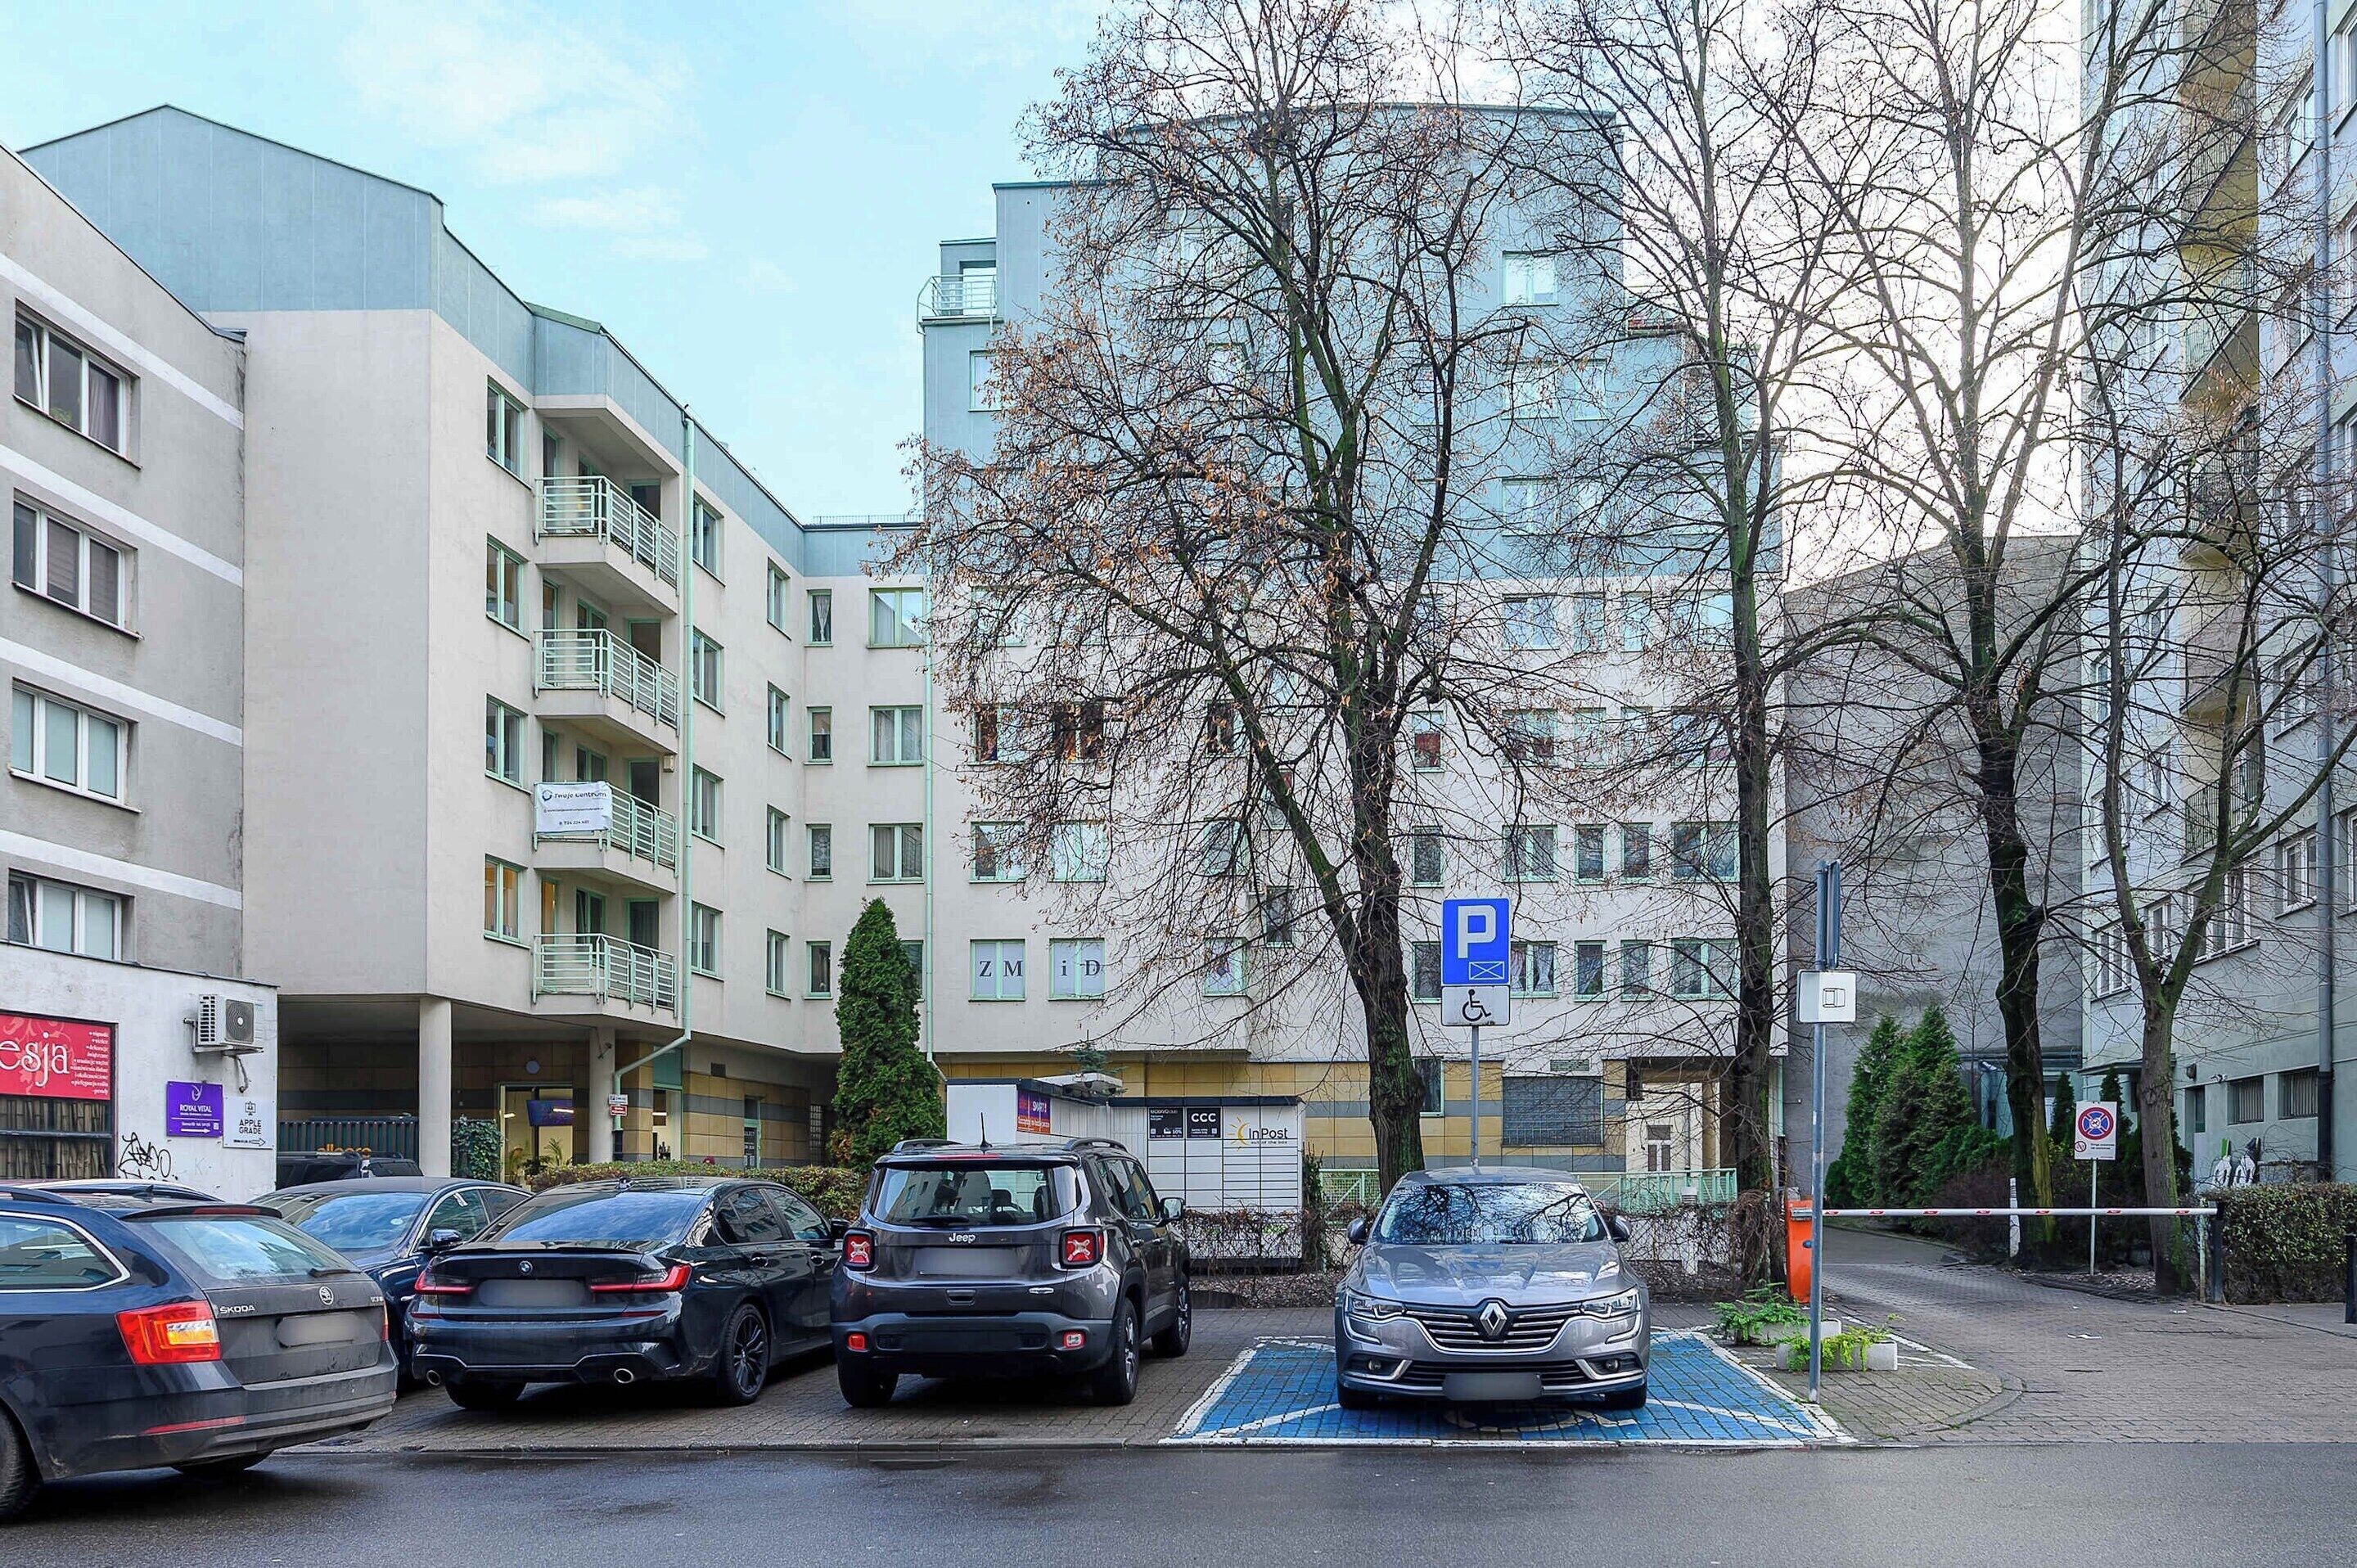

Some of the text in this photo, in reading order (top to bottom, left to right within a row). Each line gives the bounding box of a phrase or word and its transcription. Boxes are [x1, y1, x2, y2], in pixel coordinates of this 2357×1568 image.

[1458, 905, 1496, 958] P
[180, 1103, 212, 1113] ROYAL VITAL
[1191, 1113, 1216, 1122] CCC
[239, 1119, 261, 1127] APPLE
[1249, 1128, 1288, 1139] InPost
[949, 1232, 976, 1244] Jeep
